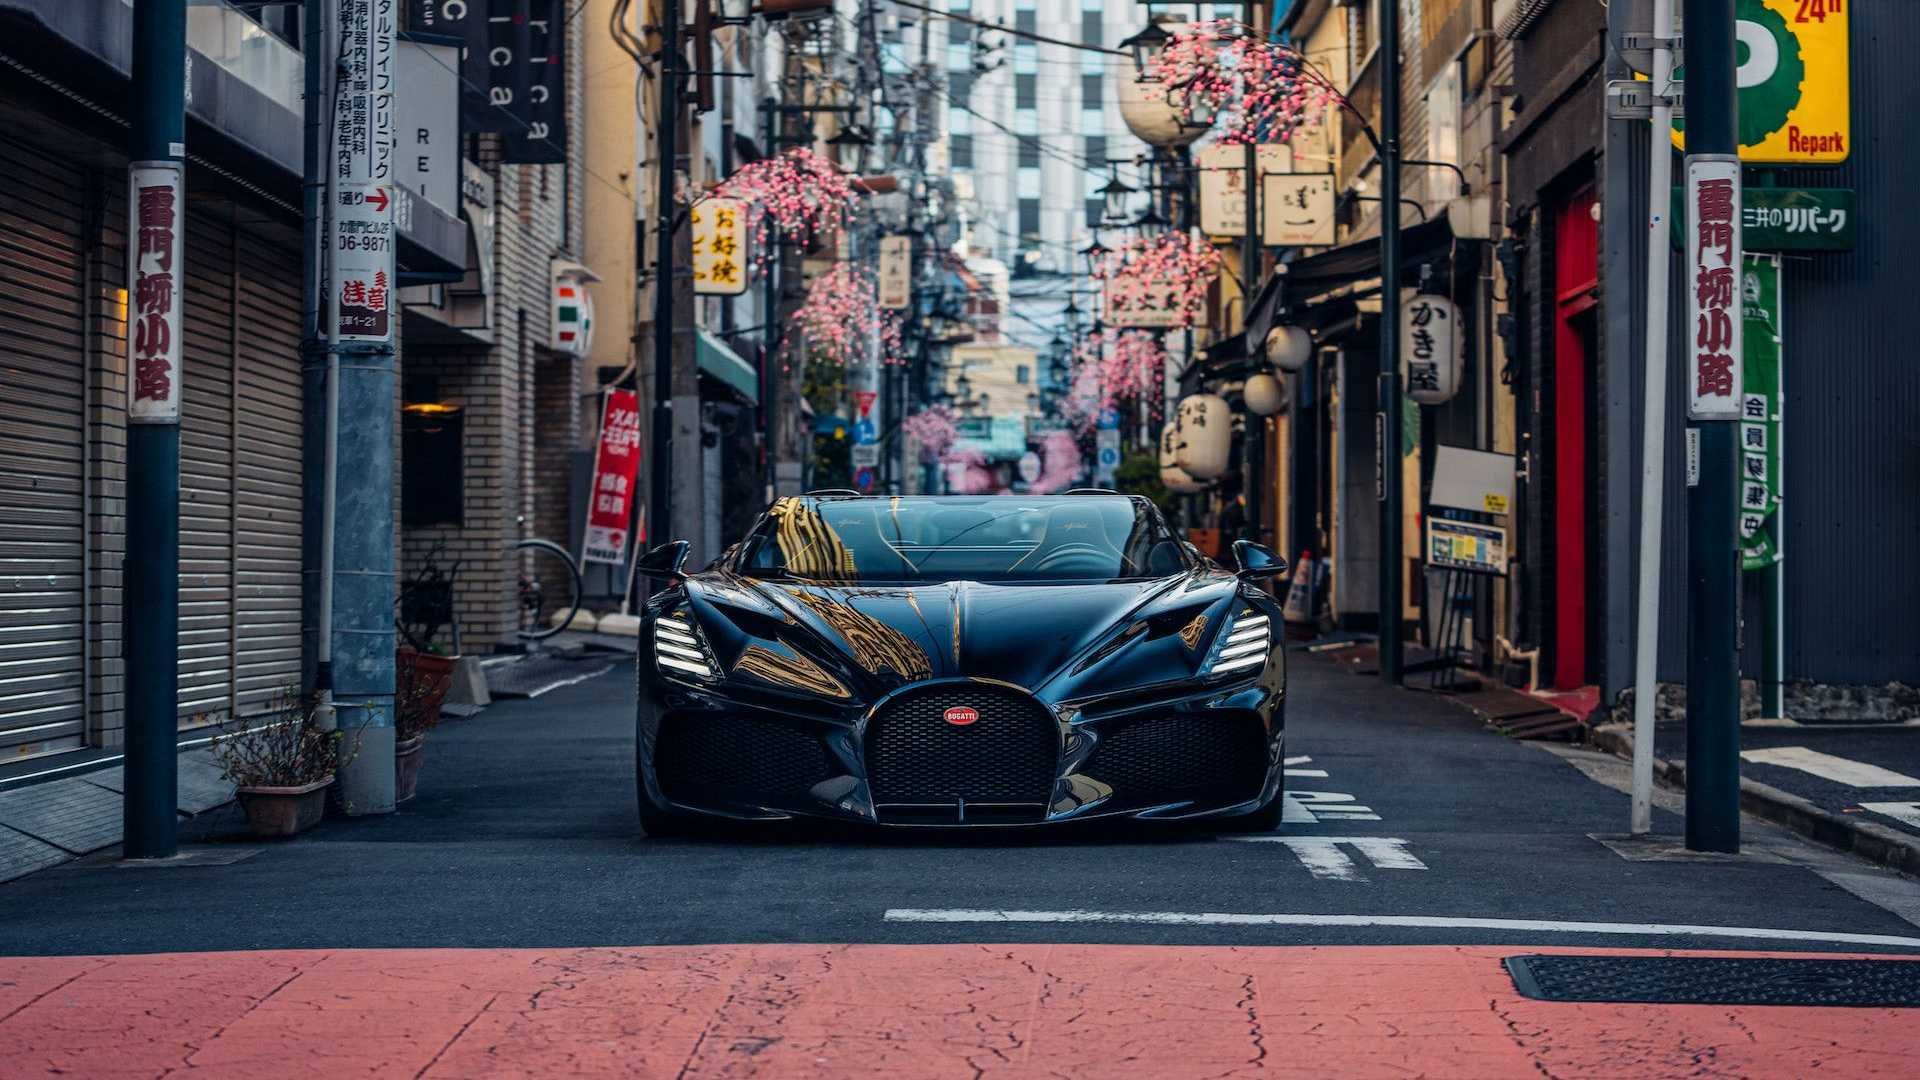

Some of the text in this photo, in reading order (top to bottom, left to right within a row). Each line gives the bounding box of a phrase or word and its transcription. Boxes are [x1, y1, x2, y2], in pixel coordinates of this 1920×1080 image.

[1788, 125, 1844, 156] Repark
[1743, 205, 1847, 233] 三井のリパーク
[343, 279, 387, 312] 浅草
[1408, 302, 1447, 392] かき屋
[947, 712, 975, 720] BUGATTI
